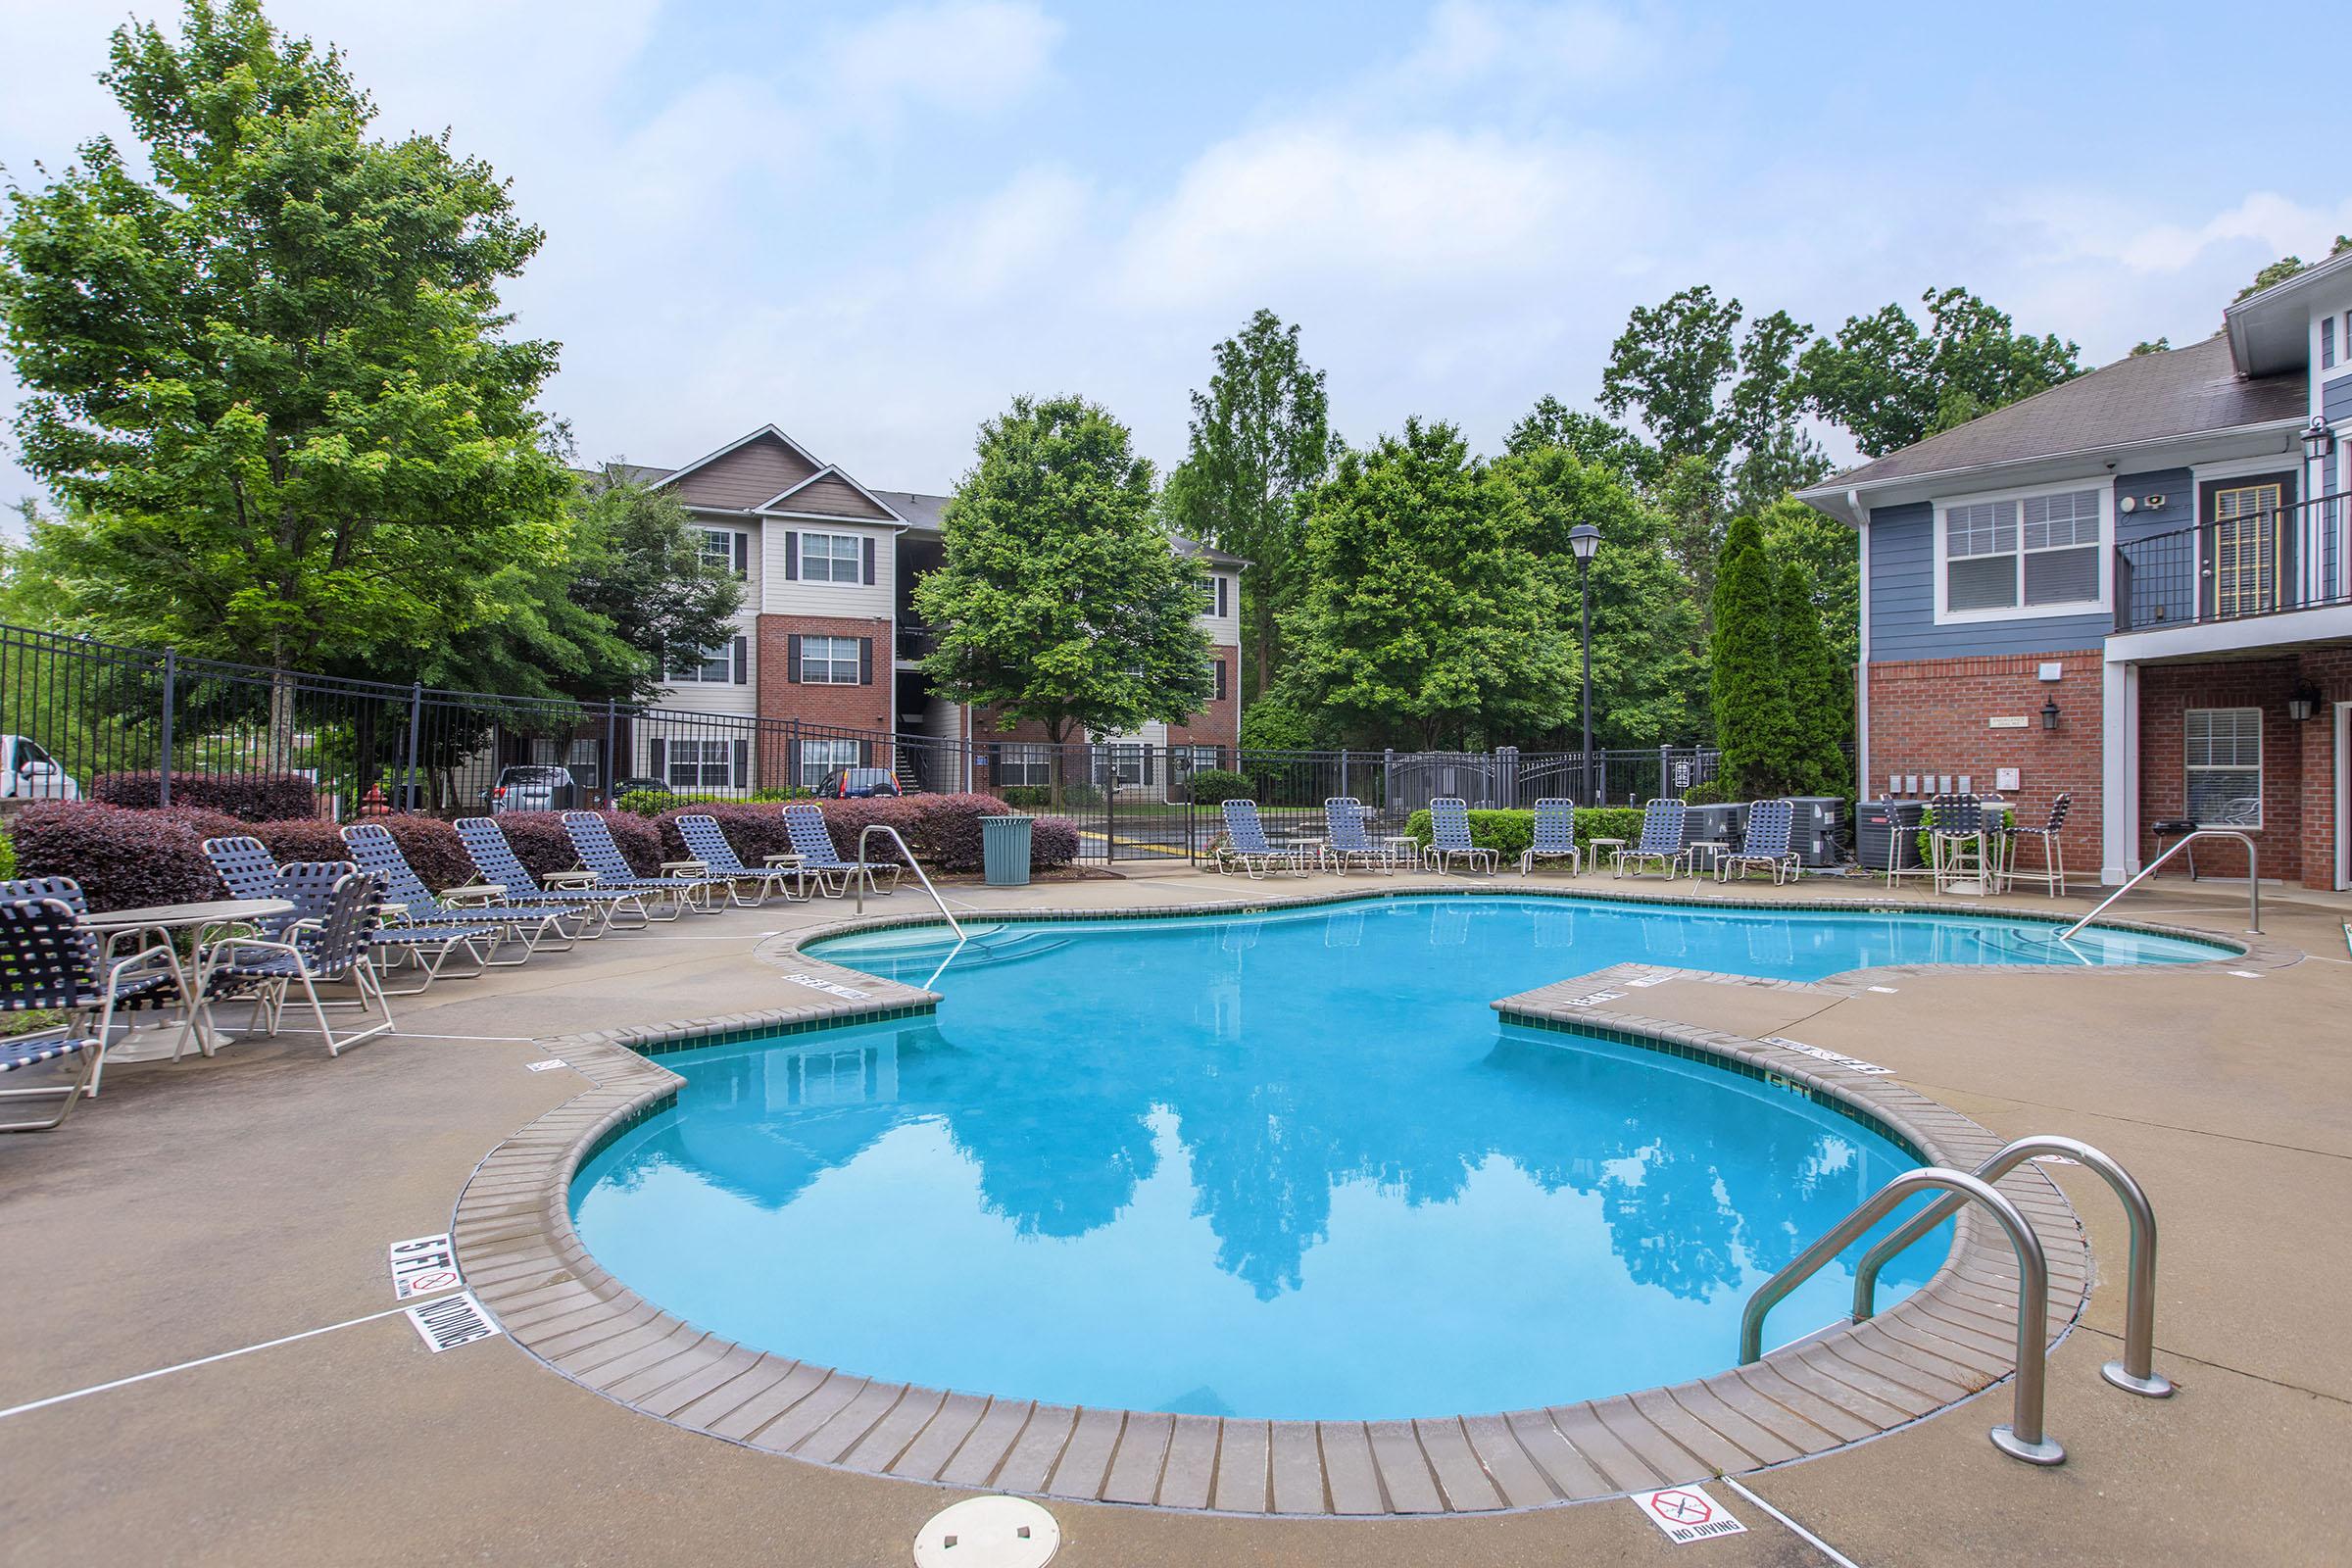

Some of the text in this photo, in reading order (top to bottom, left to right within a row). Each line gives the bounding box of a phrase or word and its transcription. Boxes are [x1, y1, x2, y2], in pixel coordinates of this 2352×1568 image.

[1770, 1073, 1809, 1098] 5 FT
[394, 1238, 452, 1275] 5 FT
[415, 1296, 492, 1348] NO DIVING
[1671, 1520, 1740, 1541] NO DIVING
